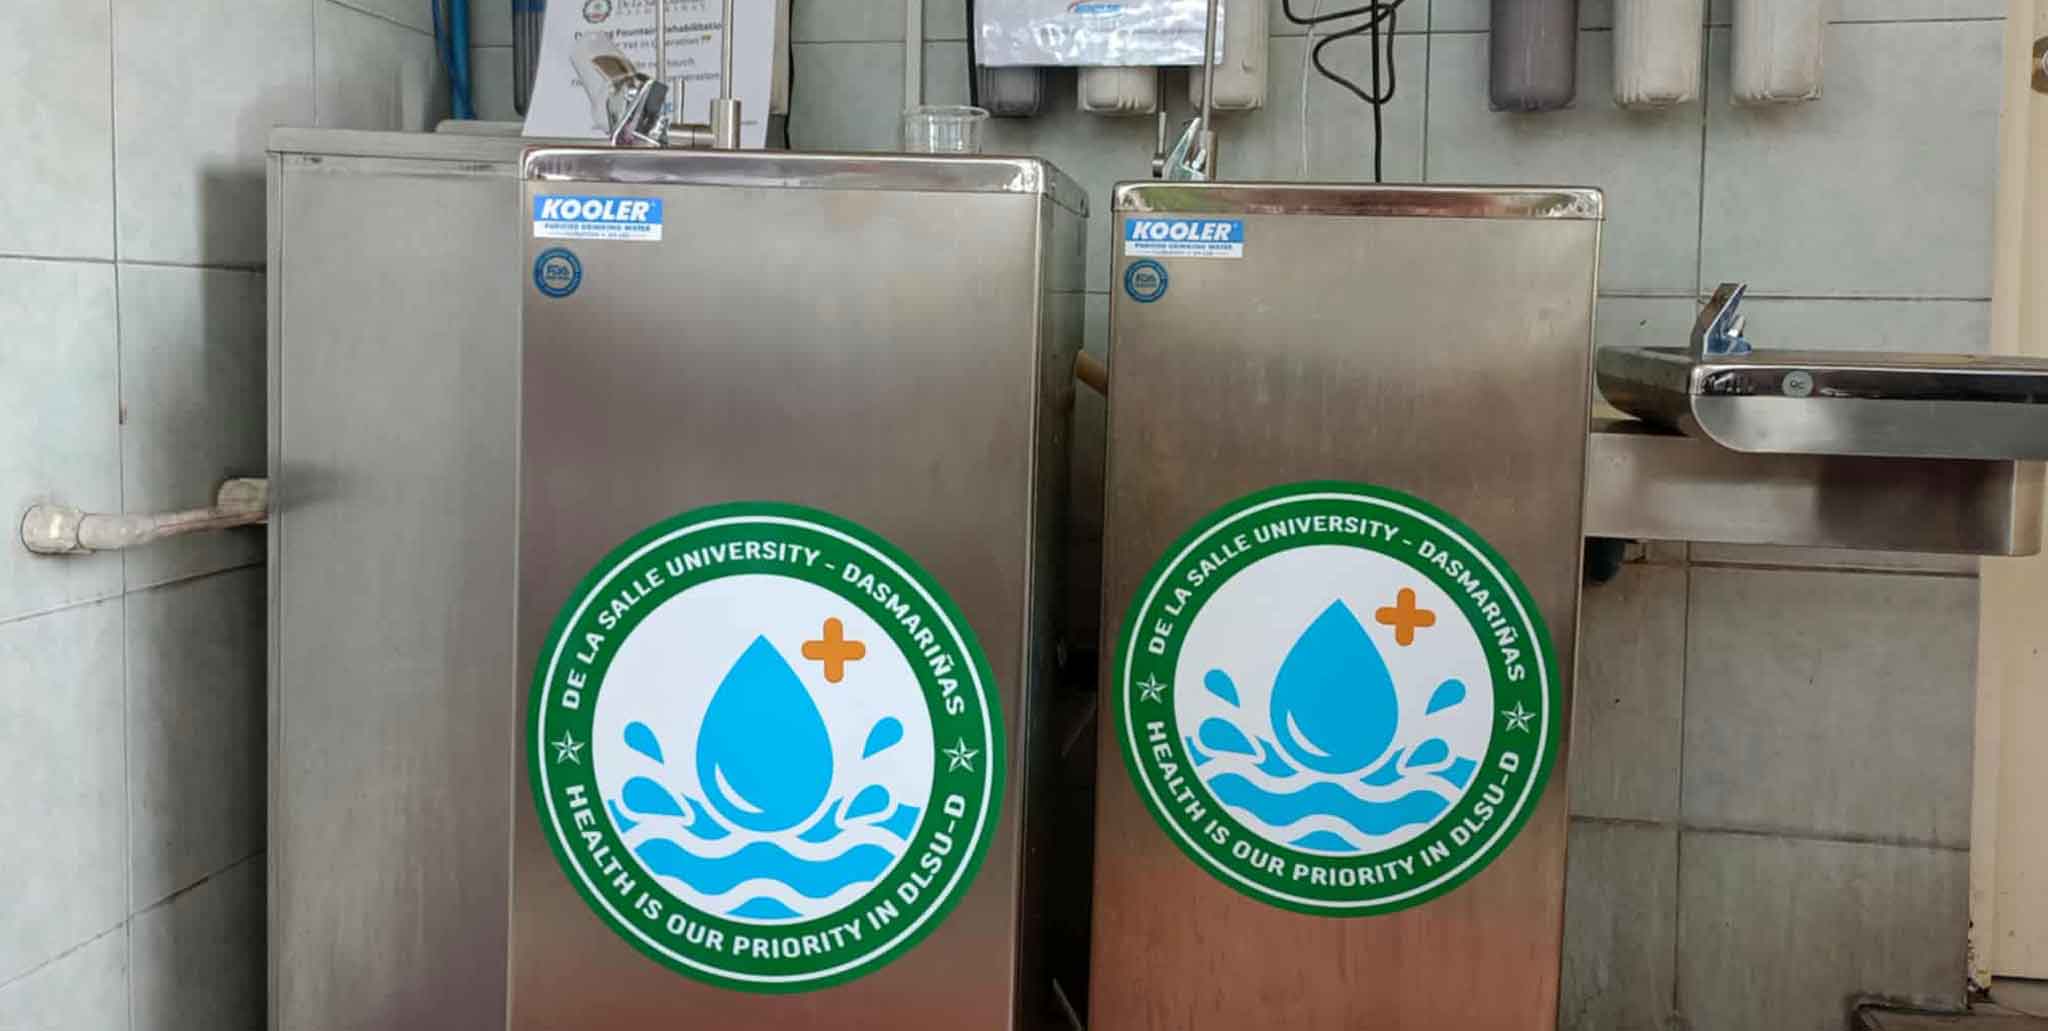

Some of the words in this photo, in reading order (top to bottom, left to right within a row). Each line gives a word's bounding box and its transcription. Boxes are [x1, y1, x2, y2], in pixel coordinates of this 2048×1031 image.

[541, 198, 650, 221] KOOLER
[1132, 220, 1232, 241] KOOLER
[562, 669, 588, 710] DE
[576, 630, 605, 665] LA
[597, 567, 665, 631] SALLE
[666, 541, 821, 578] UNIVERSITY
[842, 562, 965, 717] DASMARIÑAS
[1148, 620, 1173, 656] DE
[1166, 587, 1192, 618] LA
[1187, 534, 1251, 588] SALLE
[1253, 515, 1400, 543] UNIVERSITY
[1418, 540, 1526, 683] DASMARIÑAS
[565, 784, 636, 895] HEALTH
[635, 892, 663, 921] IS
[666, 913, 724, 952] OUR
[732, 919, 863, 959] PRIORITY
[866, 900, 900, 931] IN
[897, 793, 967, 906] DLSU-D
[1147, 720, 1206, 822] HEALTH
[1204, 819, 1230, 845] IS
[1232, 839, 1286, 877] OUR
[1292, 856, 1415, 887] PRIORITY
[1420, 840, 1451, 867] IN
[1450, 750, 1521, 846] DLSU-D
